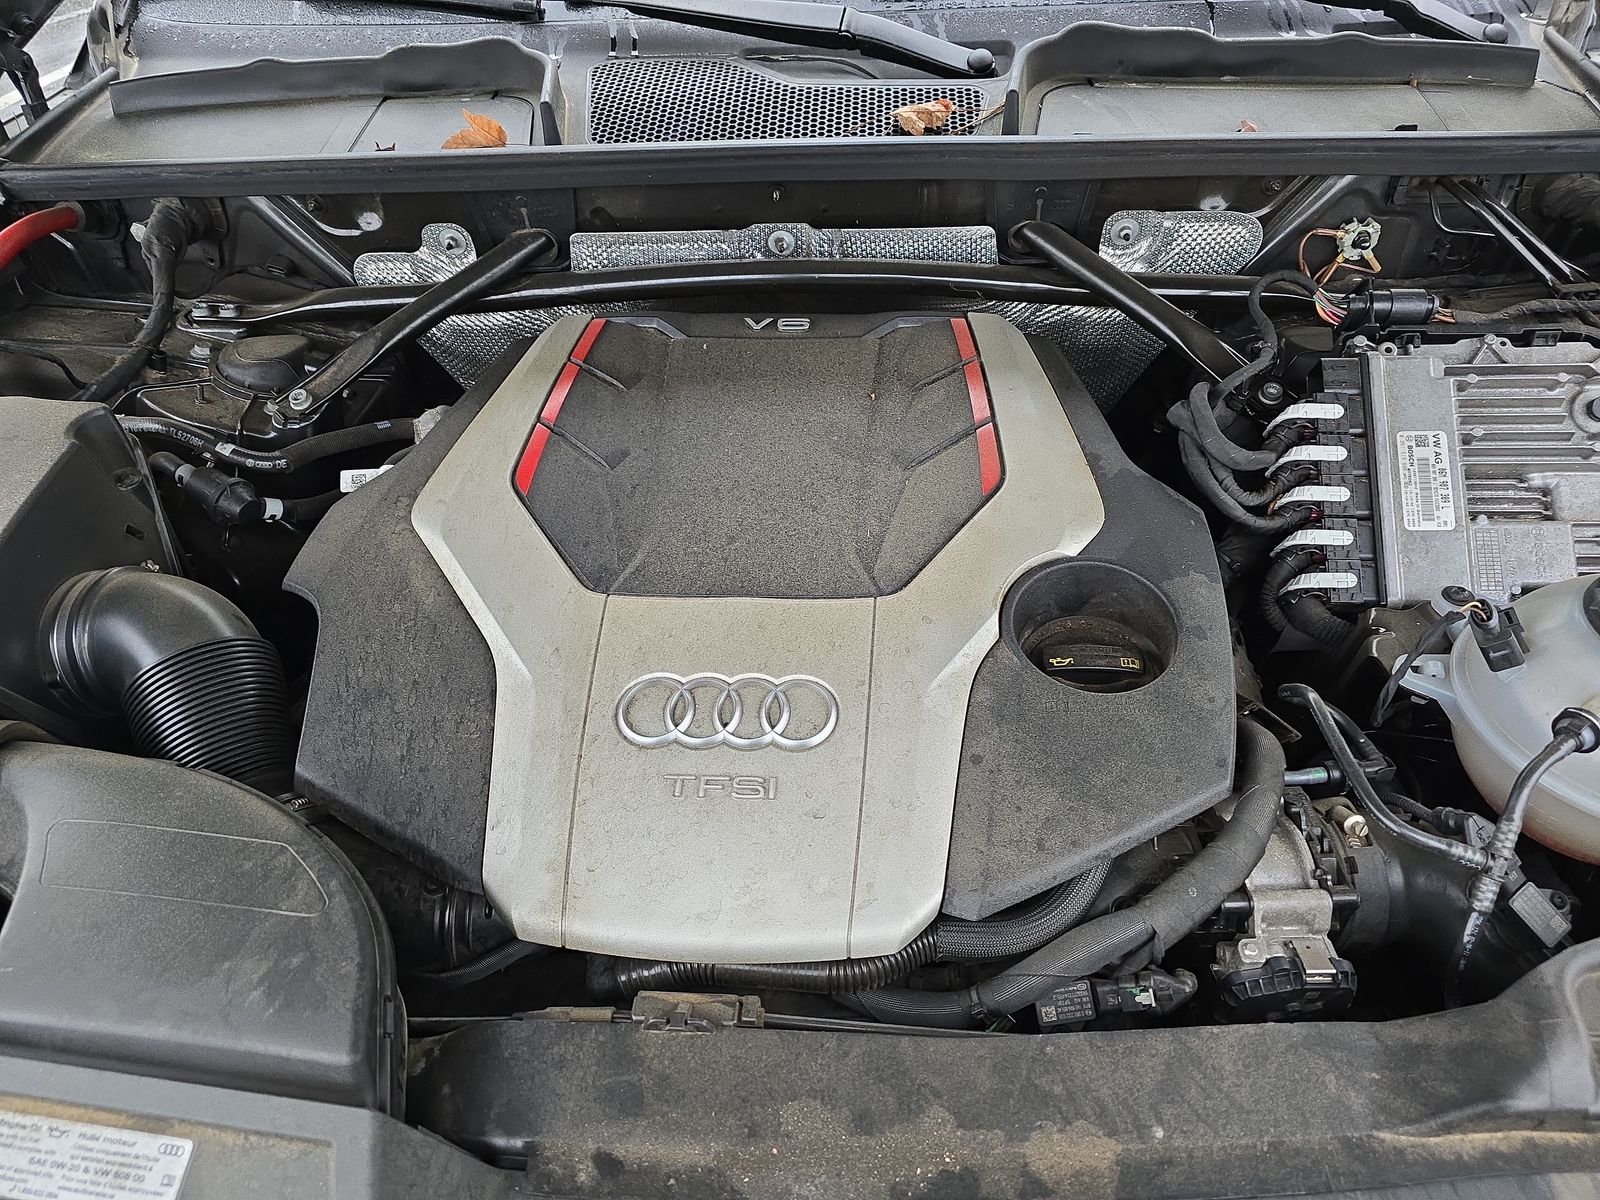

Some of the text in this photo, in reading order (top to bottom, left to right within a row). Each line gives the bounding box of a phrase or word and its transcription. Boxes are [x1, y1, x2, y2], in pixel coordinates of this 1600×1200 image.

[743, 317, 811, 331] V6
[1432, 433, 1442, 449] VW
[1407, 445, 1415, 467] BOSCH
[1433, 451, 1443, 465] AG
[663, 773, 778, 801] TFSI
[101, 1136, 138, 1148] moteur
